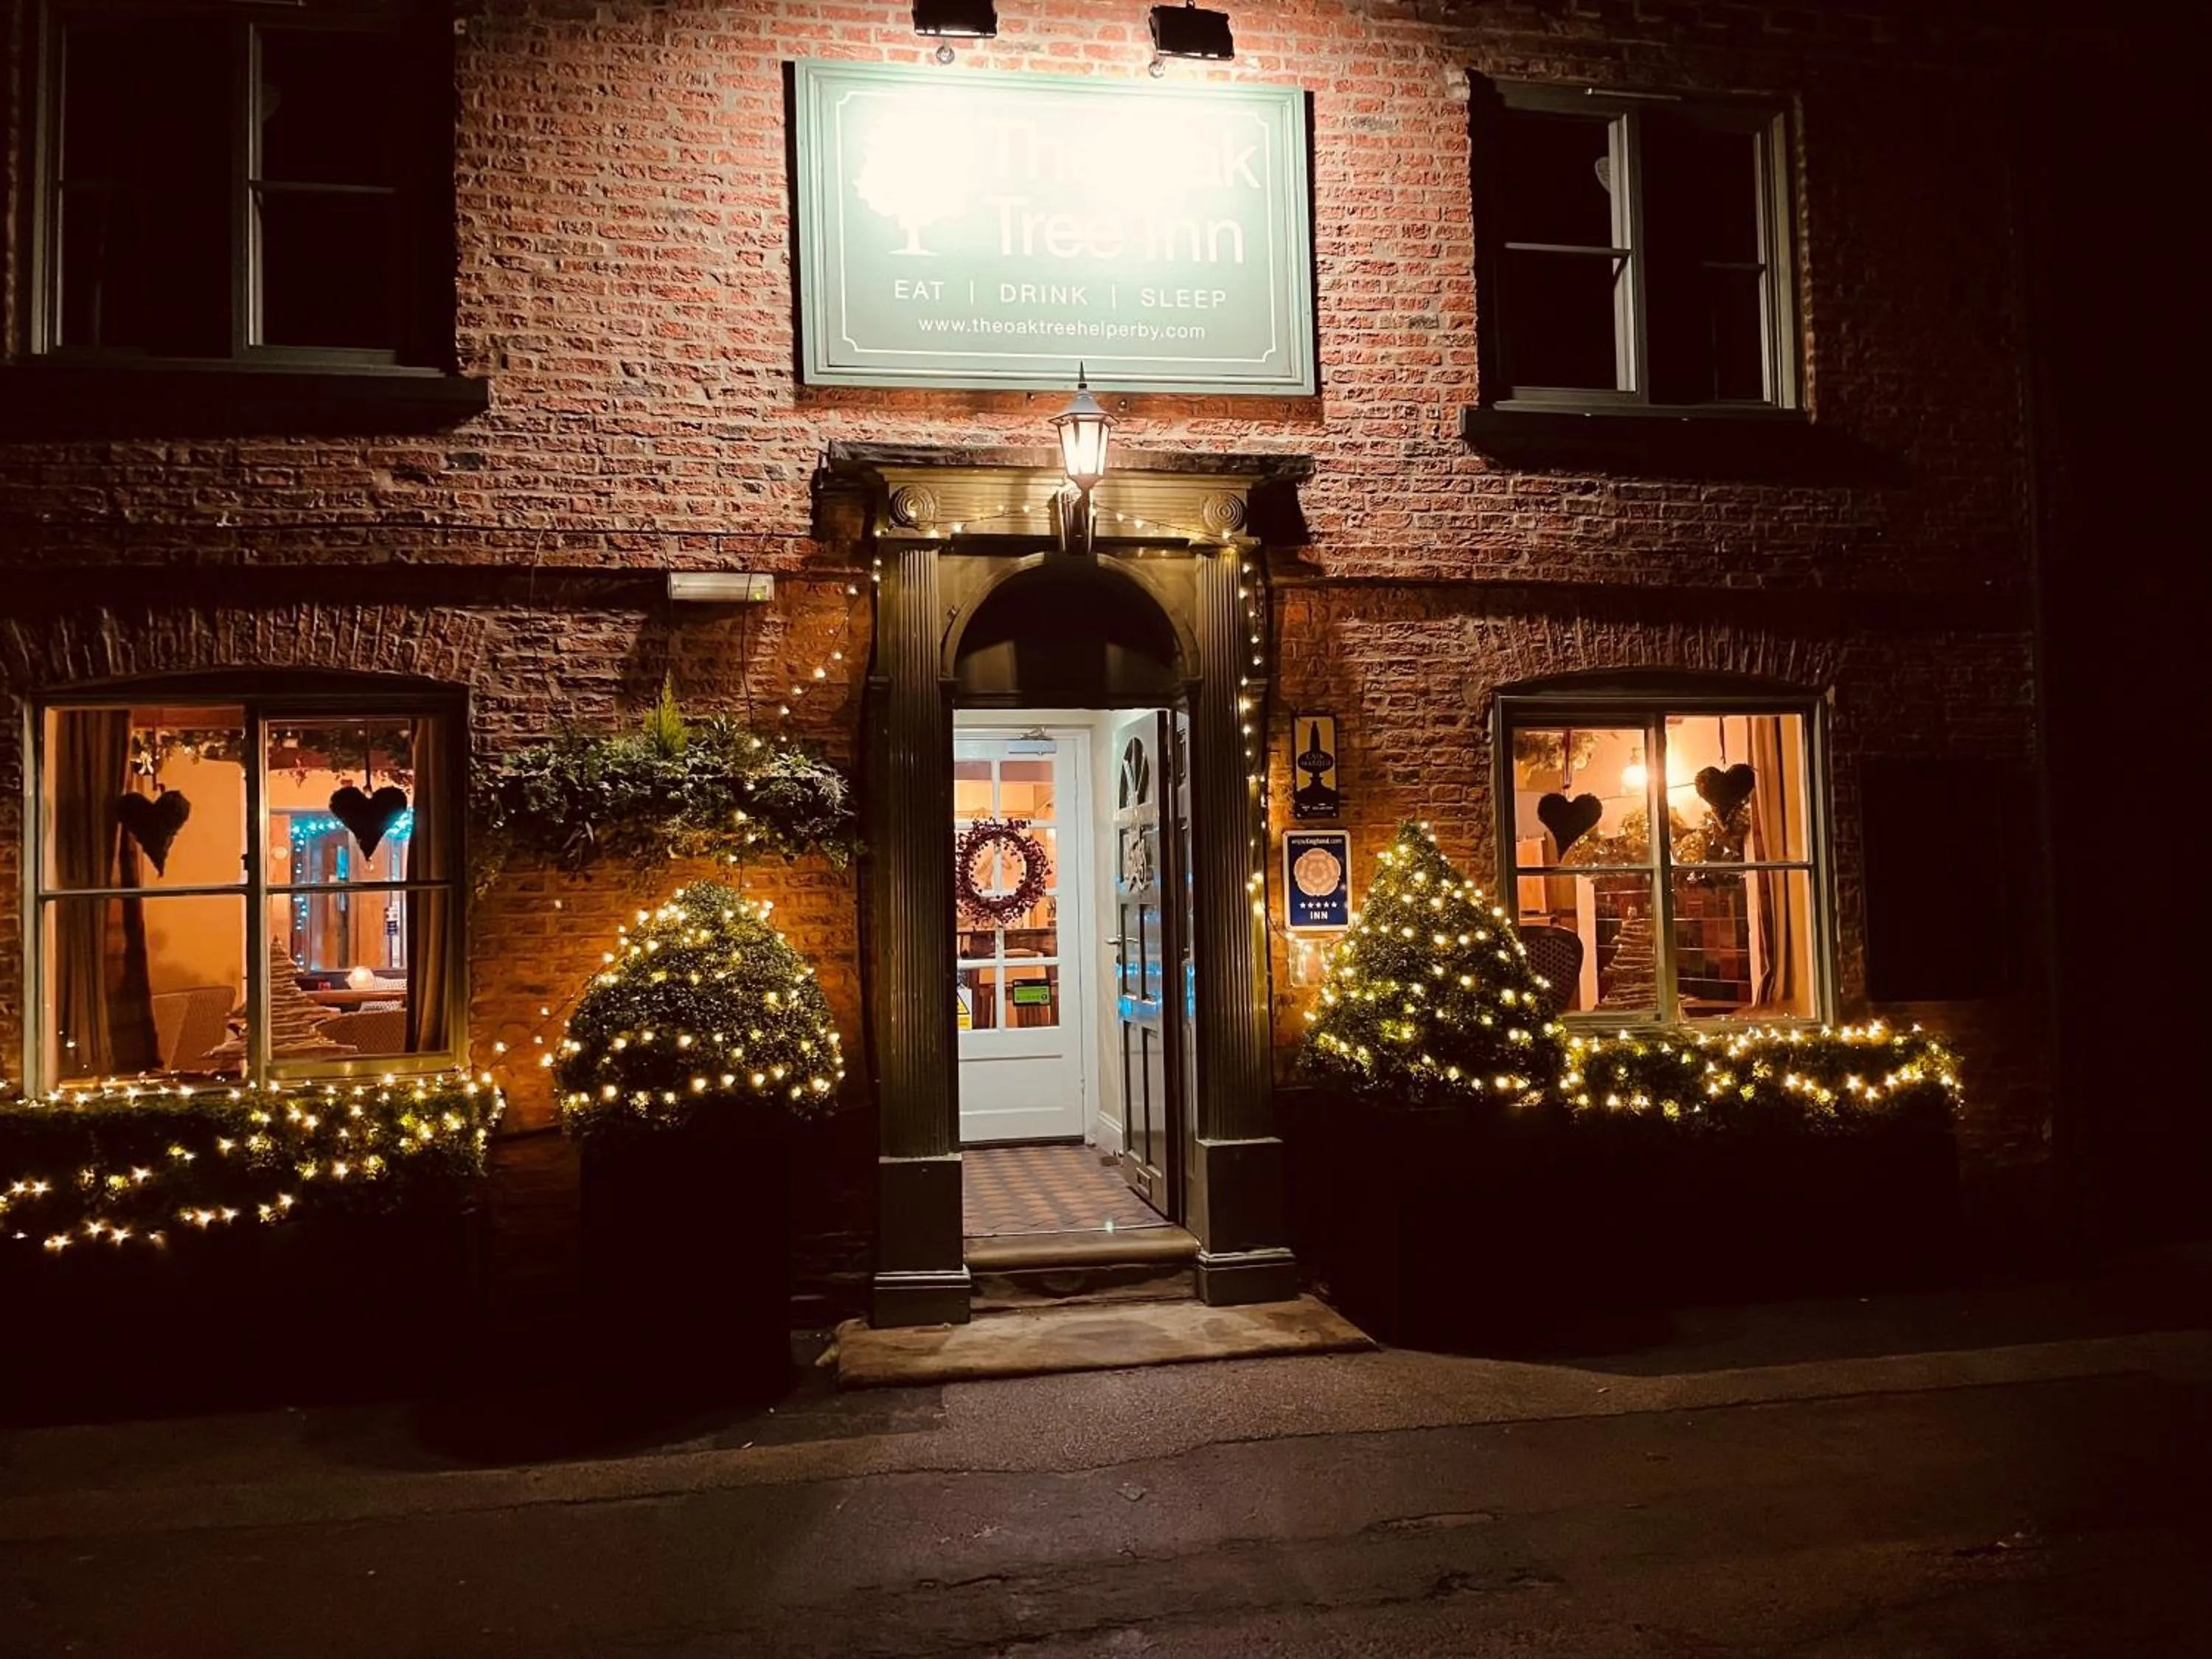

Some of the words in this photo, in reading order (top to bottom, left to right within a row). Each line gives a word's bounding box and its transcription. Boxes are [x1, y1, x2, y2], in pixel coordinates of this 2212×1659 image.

[980, 118, 1099, 186] Th
[982, 194, 1124, 260] Tree
[1145, 206, 1245, 264] Inn
[894, 279, 945, 301] EAT
[999, 282, 1089, 306] DRINK
[1140, 288, 1227, 309] SLEEP
[917, 317, 1206, 341] www.theoaktreehelperby.com
[1310, 911, 1328, 920] INN
